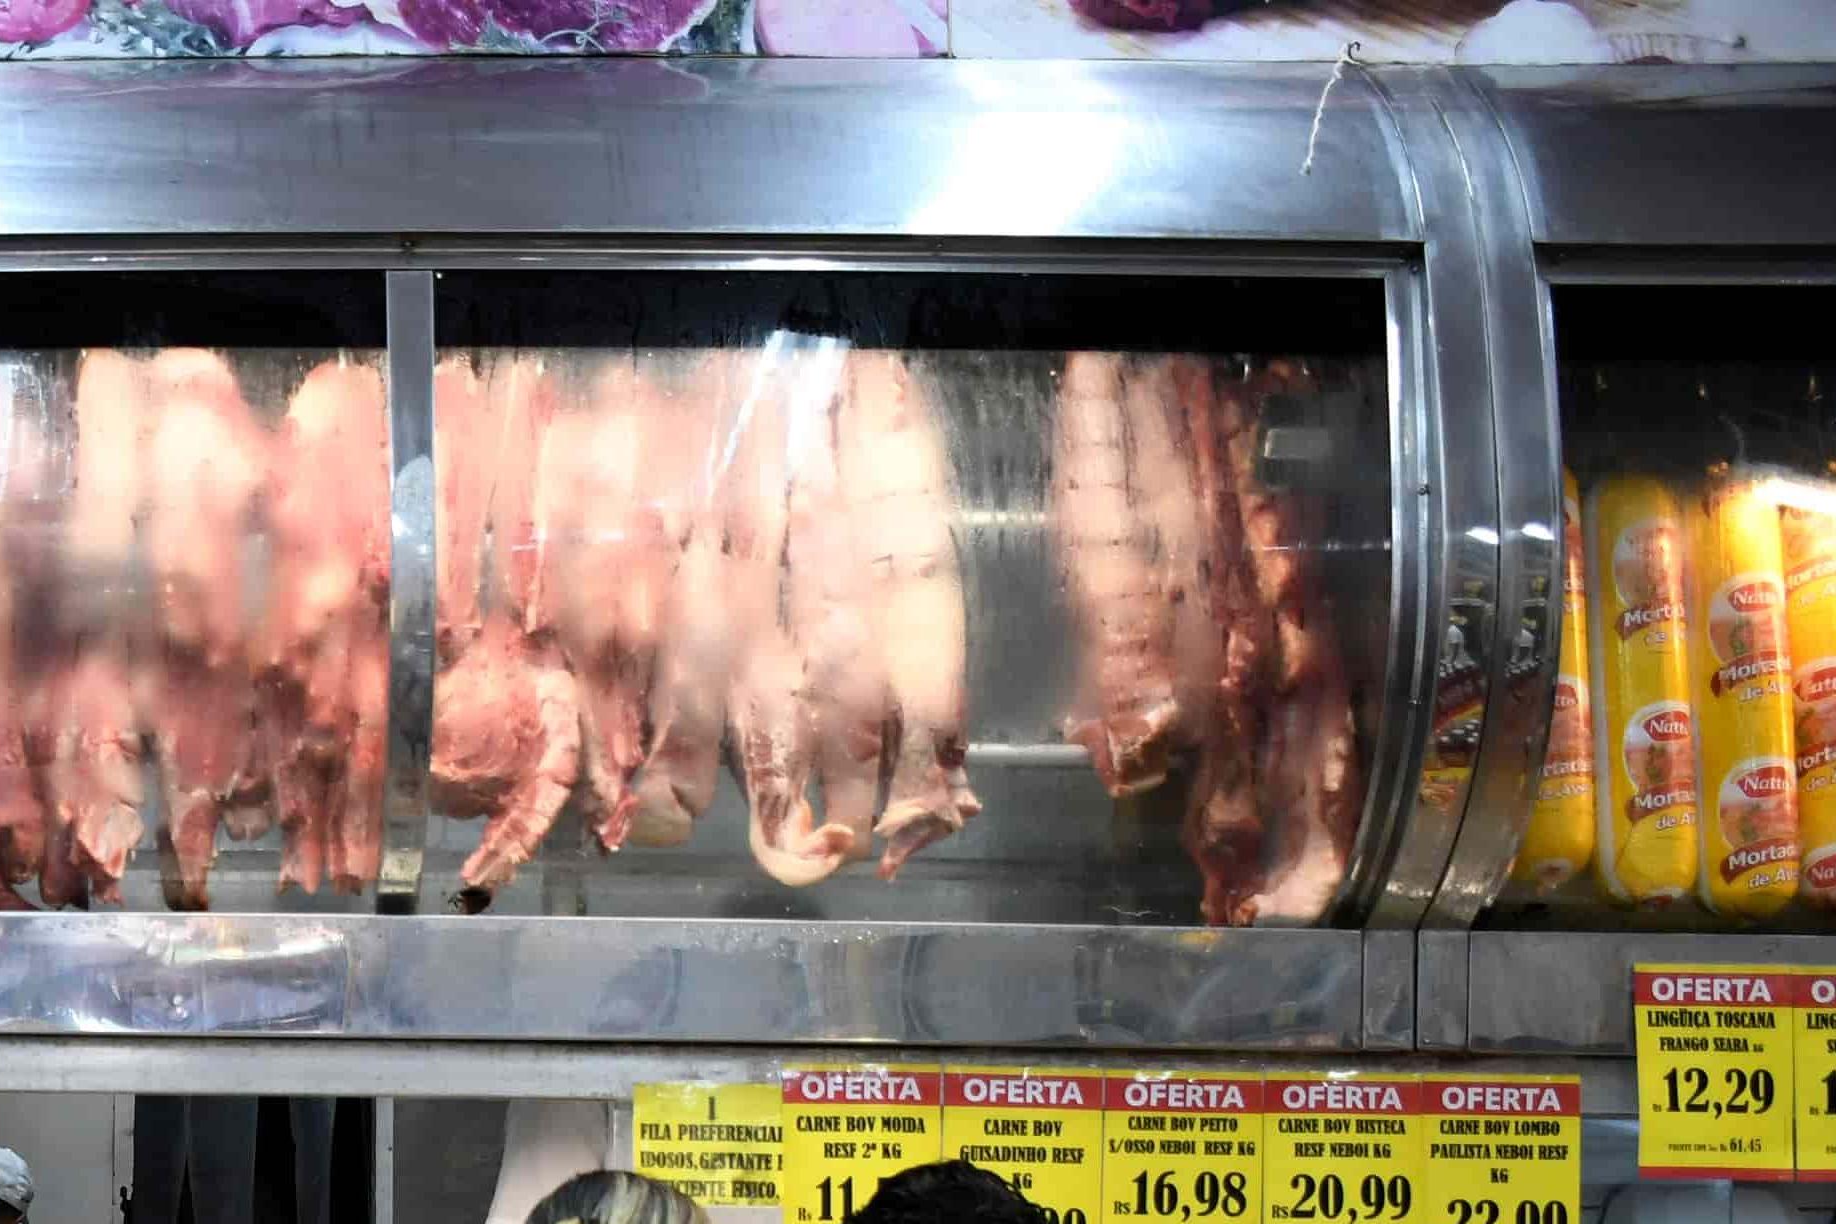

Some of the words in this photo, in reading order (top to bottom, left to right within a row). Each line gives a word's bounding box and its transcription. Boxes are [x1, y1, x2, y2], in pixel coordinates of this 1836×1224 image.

[1651, 977, 1772, 1003] OFERTA
[1647, 1008, 1711, 1031] LINGÜIÇA
[1714, 1011, 1776, 1030] TOSCANA
[1659, 1036, 1709, 1053] FRANGO
[1713, 1036, 1749, 1053] SEARA
[801, 1077, 921, 1102] OFERTA
[963, 1078, 1084, 1106] OFERTA
[1124, 1082, 1245, 1109] OFERTA
[1282, 1084, 1403, 1110] OFERTA
[1443, 1086, 1561, 1112] OFERTA
[1662, 1067, 1775, 1120] 12,29
[640, 1123, 671, 1142] FILA
[796, 1116, 841, 1134] CARNE
[845, 1116, 876, 1134] BOV
[880, 1116, 925, 1135] MOIDA
[983, 1118, 1028, 1137] CARNE
[1032, 1119, 1063, 1137] BOV
[1128, 1115, 1166, 1132] CARNE
[1170, 1116, 1196, 1132] BOV
[1200, 1116, 1238, 1133] PEITO
[1278, 1118, 1320, 1135] CARNE
[1323, 1119, 1352, 1135] BOV
[1355, 1119, 1407, 1136] BISTECA
[1440, 1120, 1481, 1136] CARNE
[1484, 1120, 1511, 1136] BOV
[1514, 1120, 1561, 1136] LOMBO
[823, 1142, 857, 1160] RESF
[881, 1143, 902, 1160] KG
[1051, 1147, 1085, 1165] RESF
[1109, 1138, 1155, 1155] S/OSSO
[1159, 1139, 1196, 1155] NEBOI
[1204, 1140, 1234, 1156] RESF
[1237, 1141, 1256, 1156] KG
[1294, 1142, 1325, 1159] RESF
[1329, 1143, 1370, 1159] NEBOI
[1373, 1143, 1392, 1159] KG
[1430, 1143, 1493, 1161] PAULISTA
[1495, 1144, 1535, 1161] NEBOI
[1539, 1145, 1569, 1161] RESF
[1490, 1167, 1509, 1184] KG
[1132, 1170, 1247, 1222] 16,98
